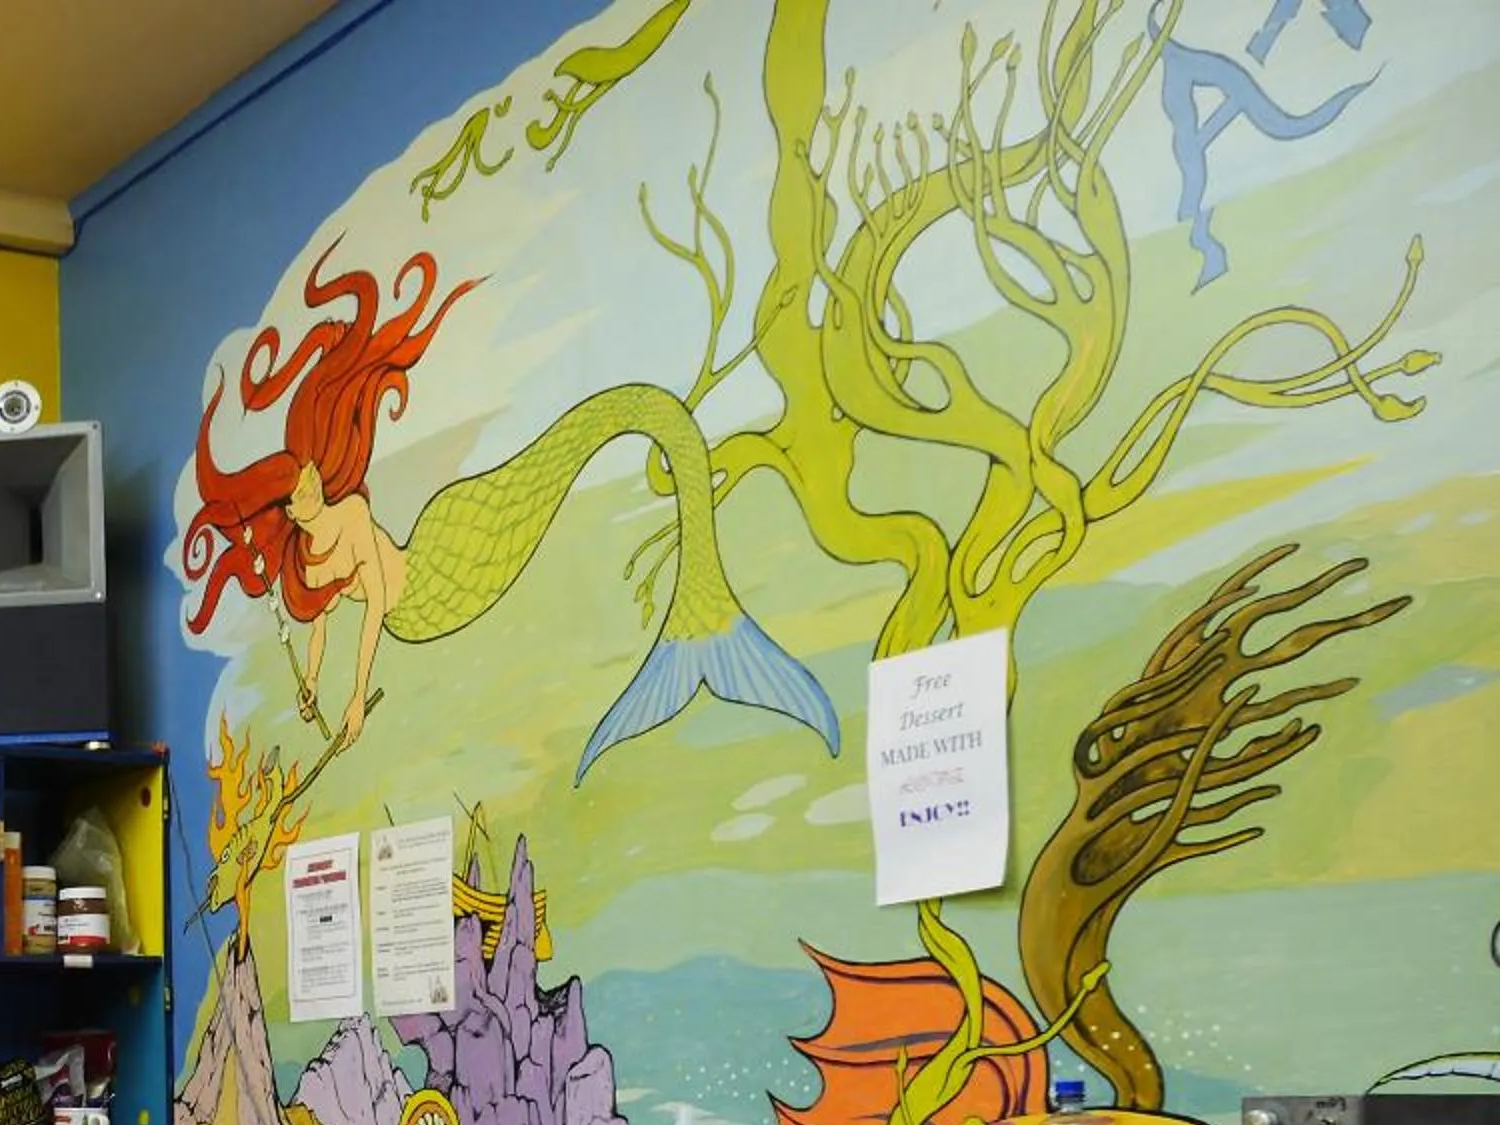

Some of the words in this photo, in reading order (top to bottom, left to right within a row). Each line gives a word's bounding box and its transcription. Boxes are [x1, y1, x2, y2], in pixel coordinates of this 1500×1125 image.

[908, 673, 952, 699] Free
[881, 742, 931, 766] MADE
[932, 729, 982, 754] WITH
